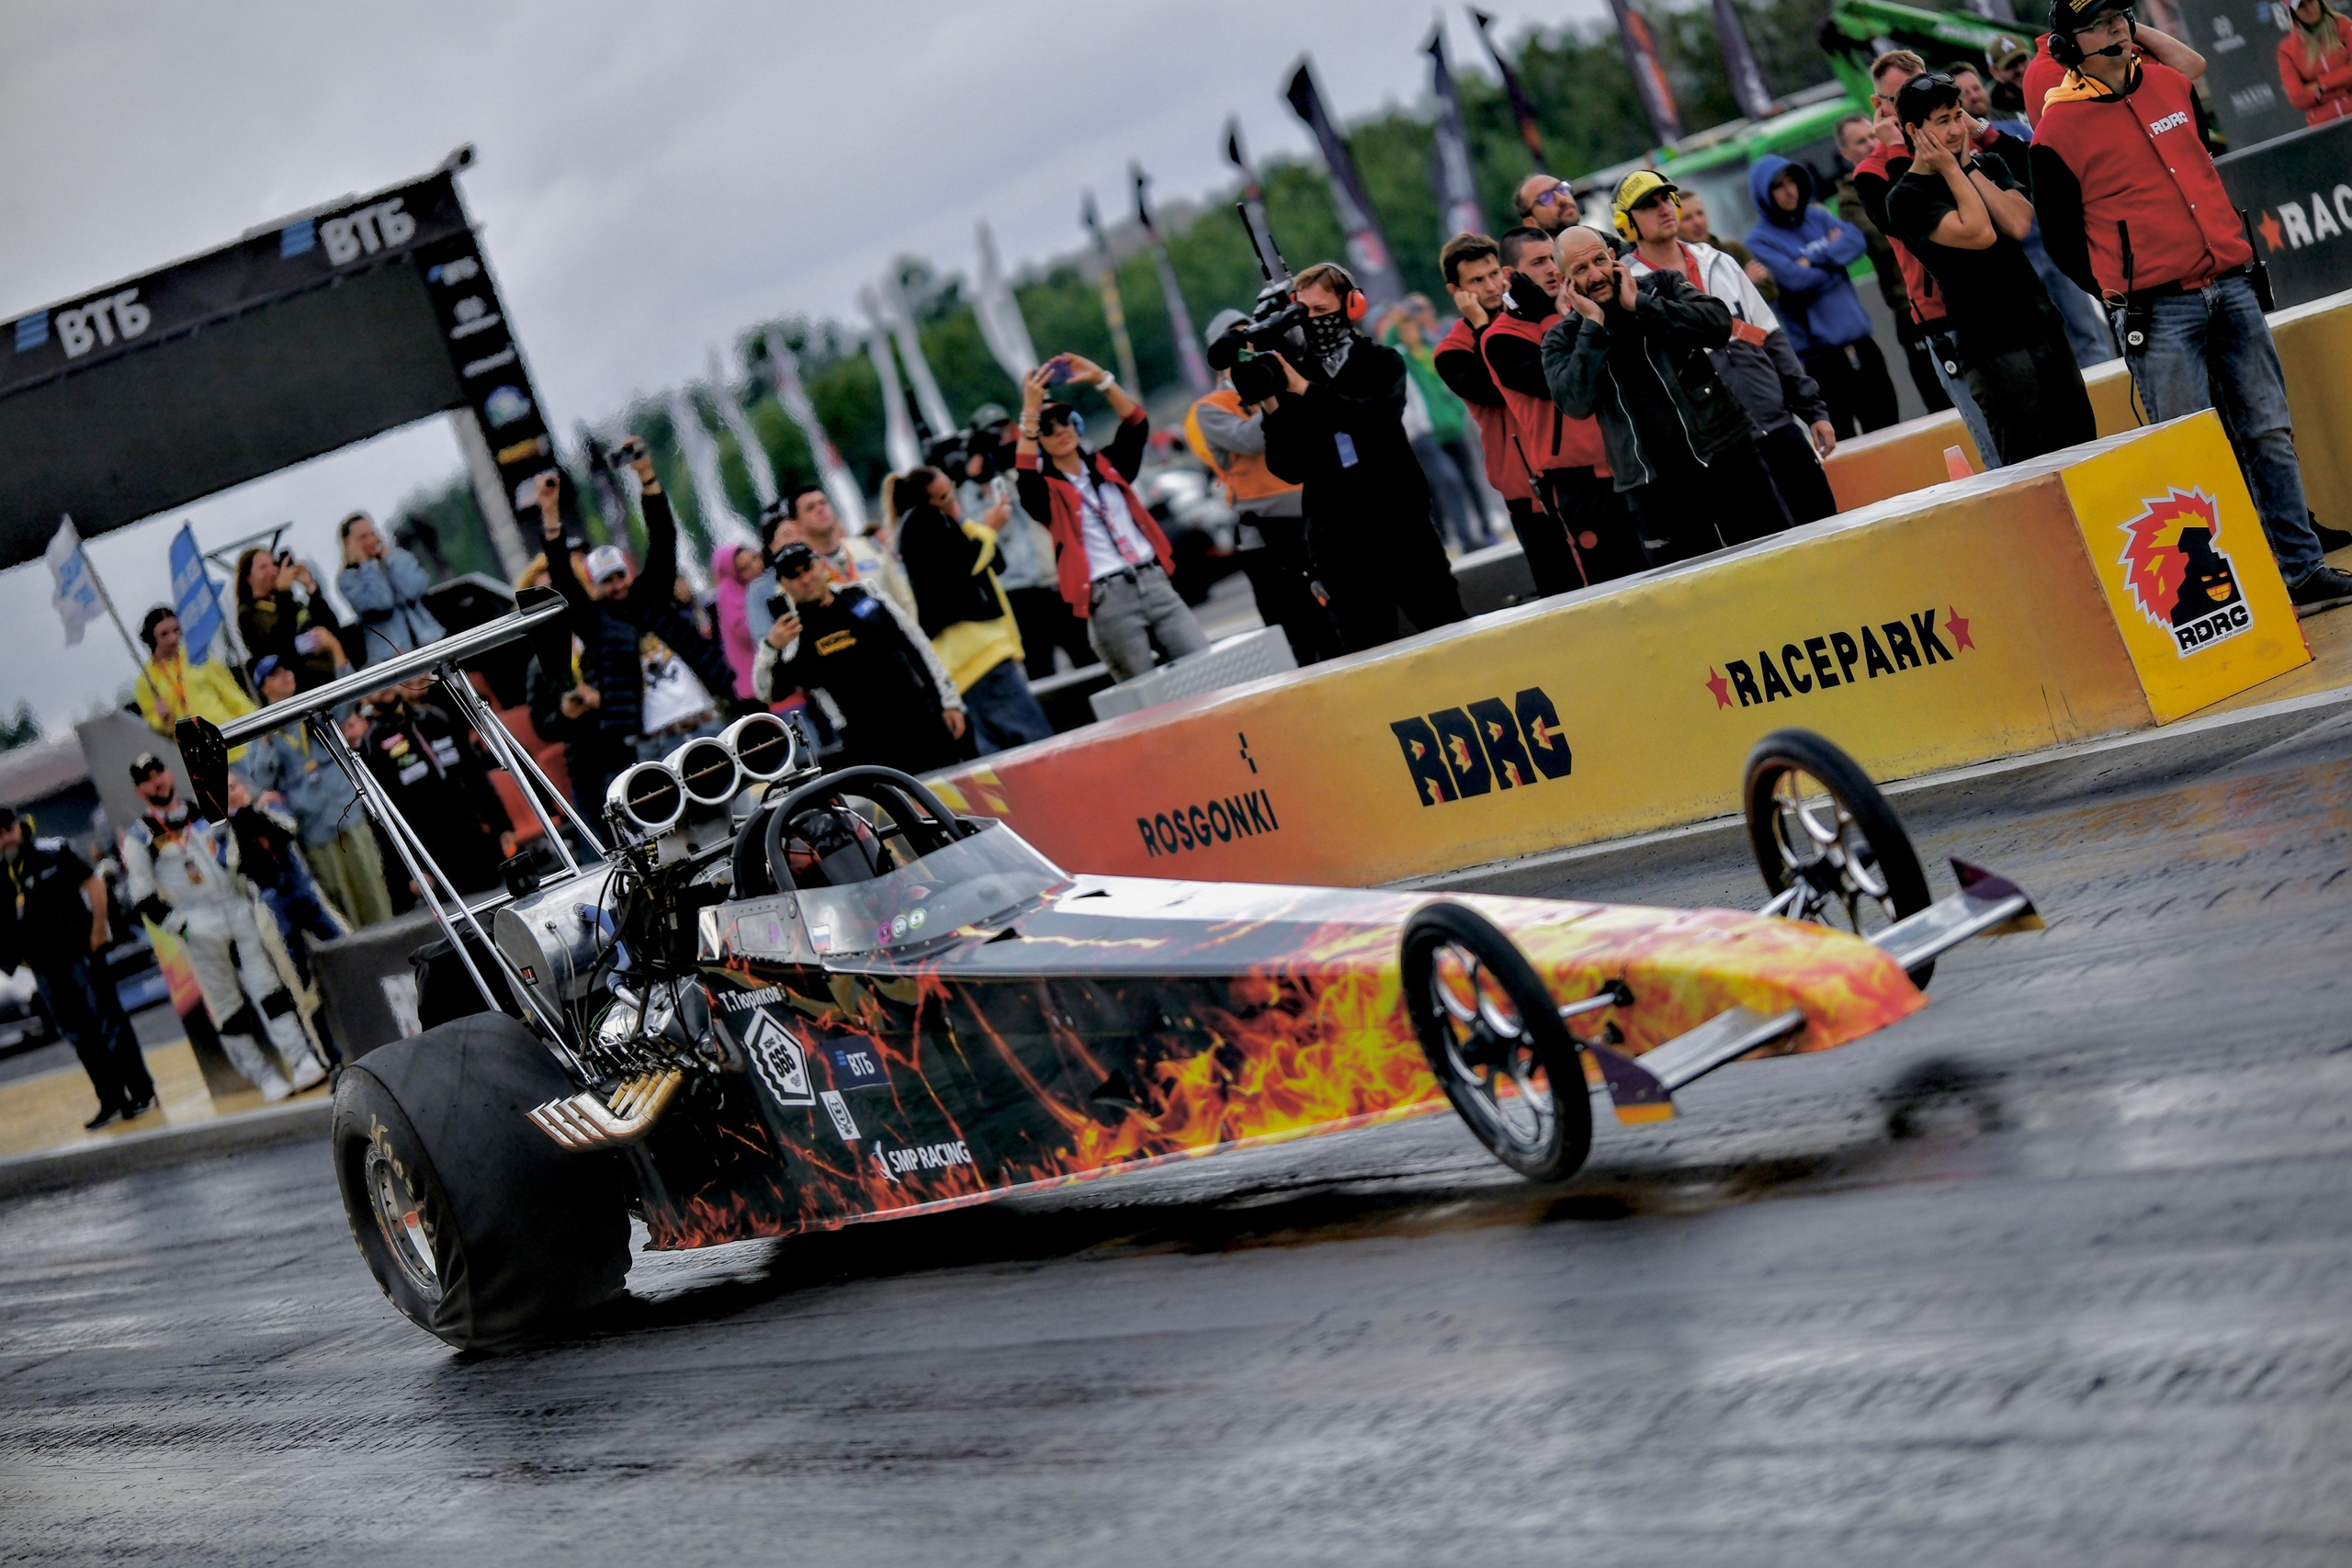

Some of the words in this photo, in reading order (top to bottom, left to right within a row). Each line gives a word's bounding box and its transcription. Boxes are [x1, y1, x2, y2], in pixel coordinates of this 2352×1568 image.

[319, 197, 416, 266] ВТБ
[55, 288, 151, 359] ВТБ
[2175, 605, 2249, 650] RDRC
[1725, 608, 1954, 707] RACEPARK
[1136, 788, 1279, 857] ROSGONKI
[768, 1043, 797, 1078] 666
[846, 1051, 876, 1077] ВТБ
[888, 1148, 919, 1173] SMP
[919, 1140, 972, 1168] RACING
